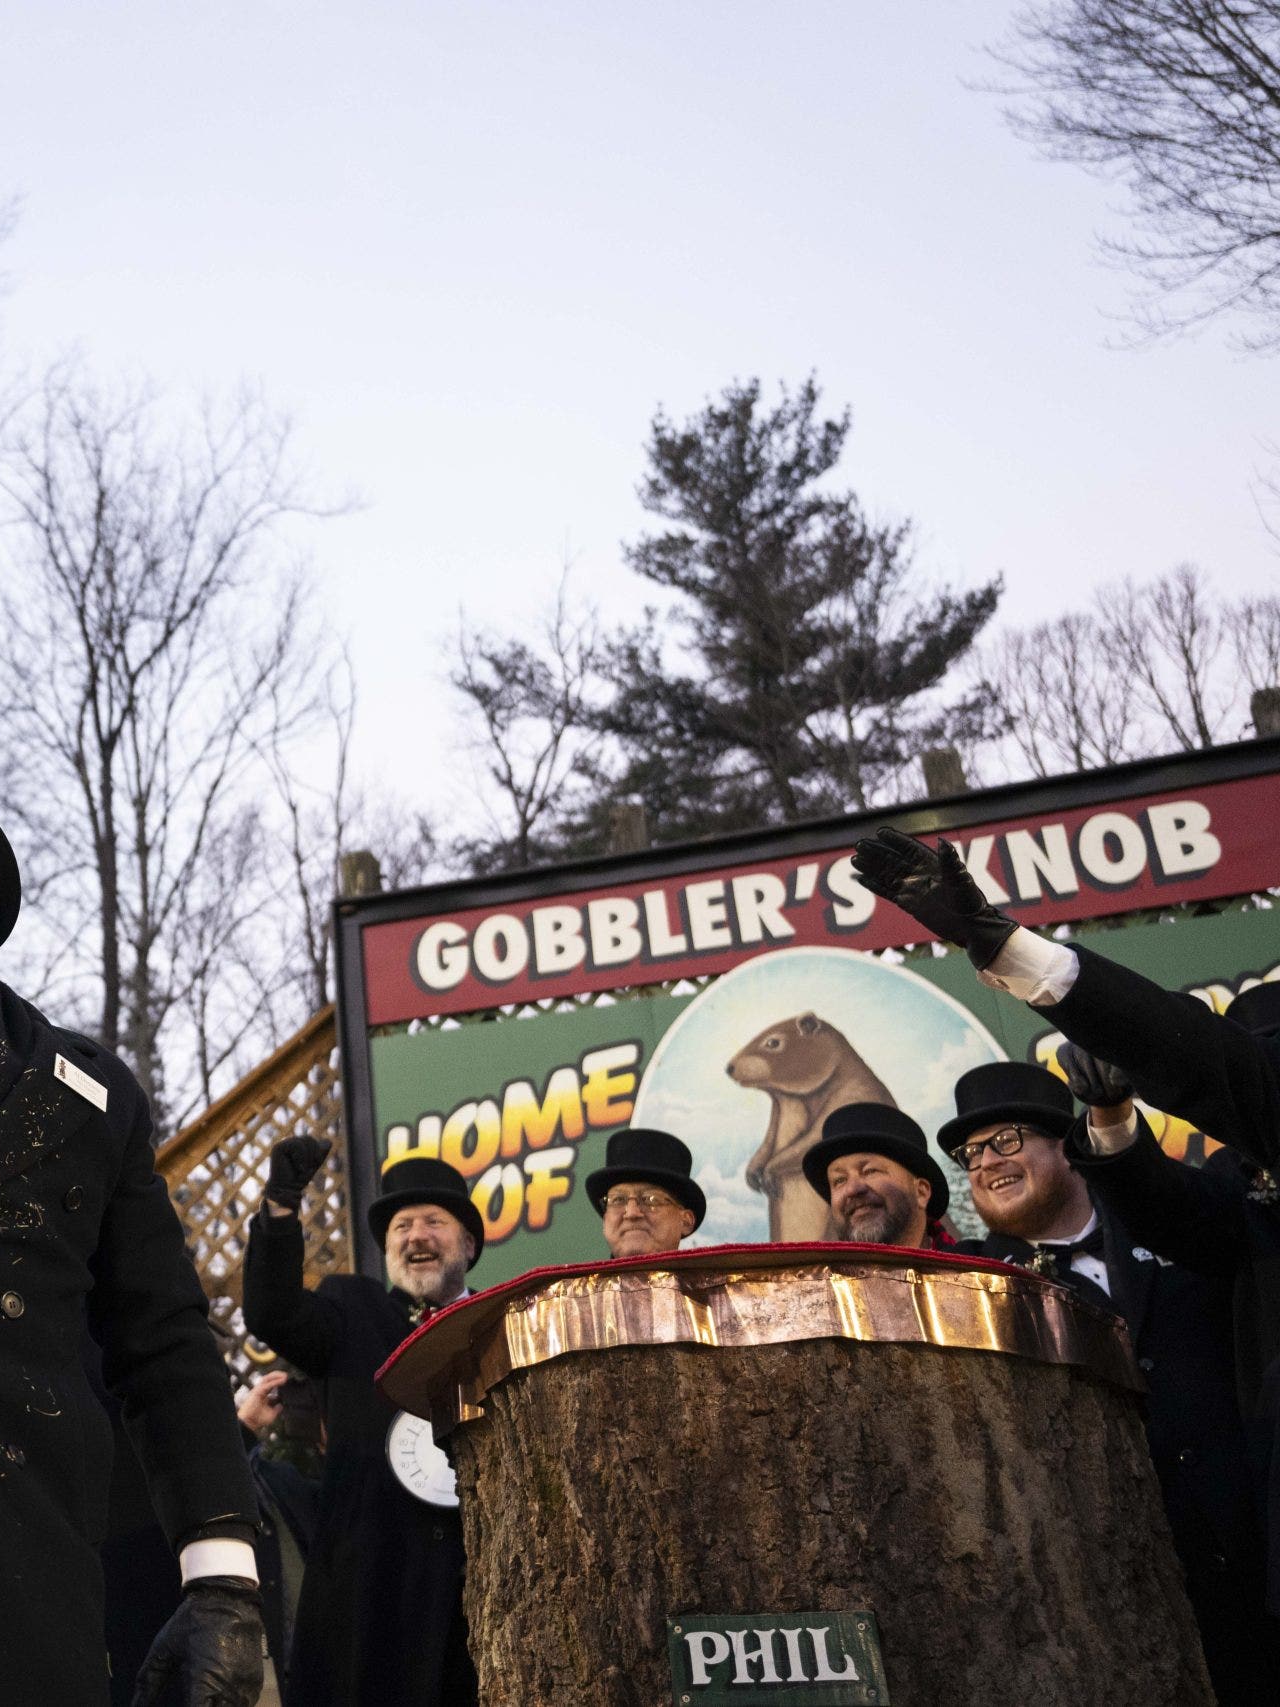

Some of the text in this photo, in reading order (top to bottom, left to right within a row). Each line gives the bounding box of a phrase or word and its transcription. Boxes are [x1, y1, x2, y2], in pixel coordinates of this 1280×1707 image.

[415, 800, 1222, 991] GOBBLER'S KNOB
[469, 1146, 576, 1242] OF
[683, 1626, 860, 1685] PHIL
